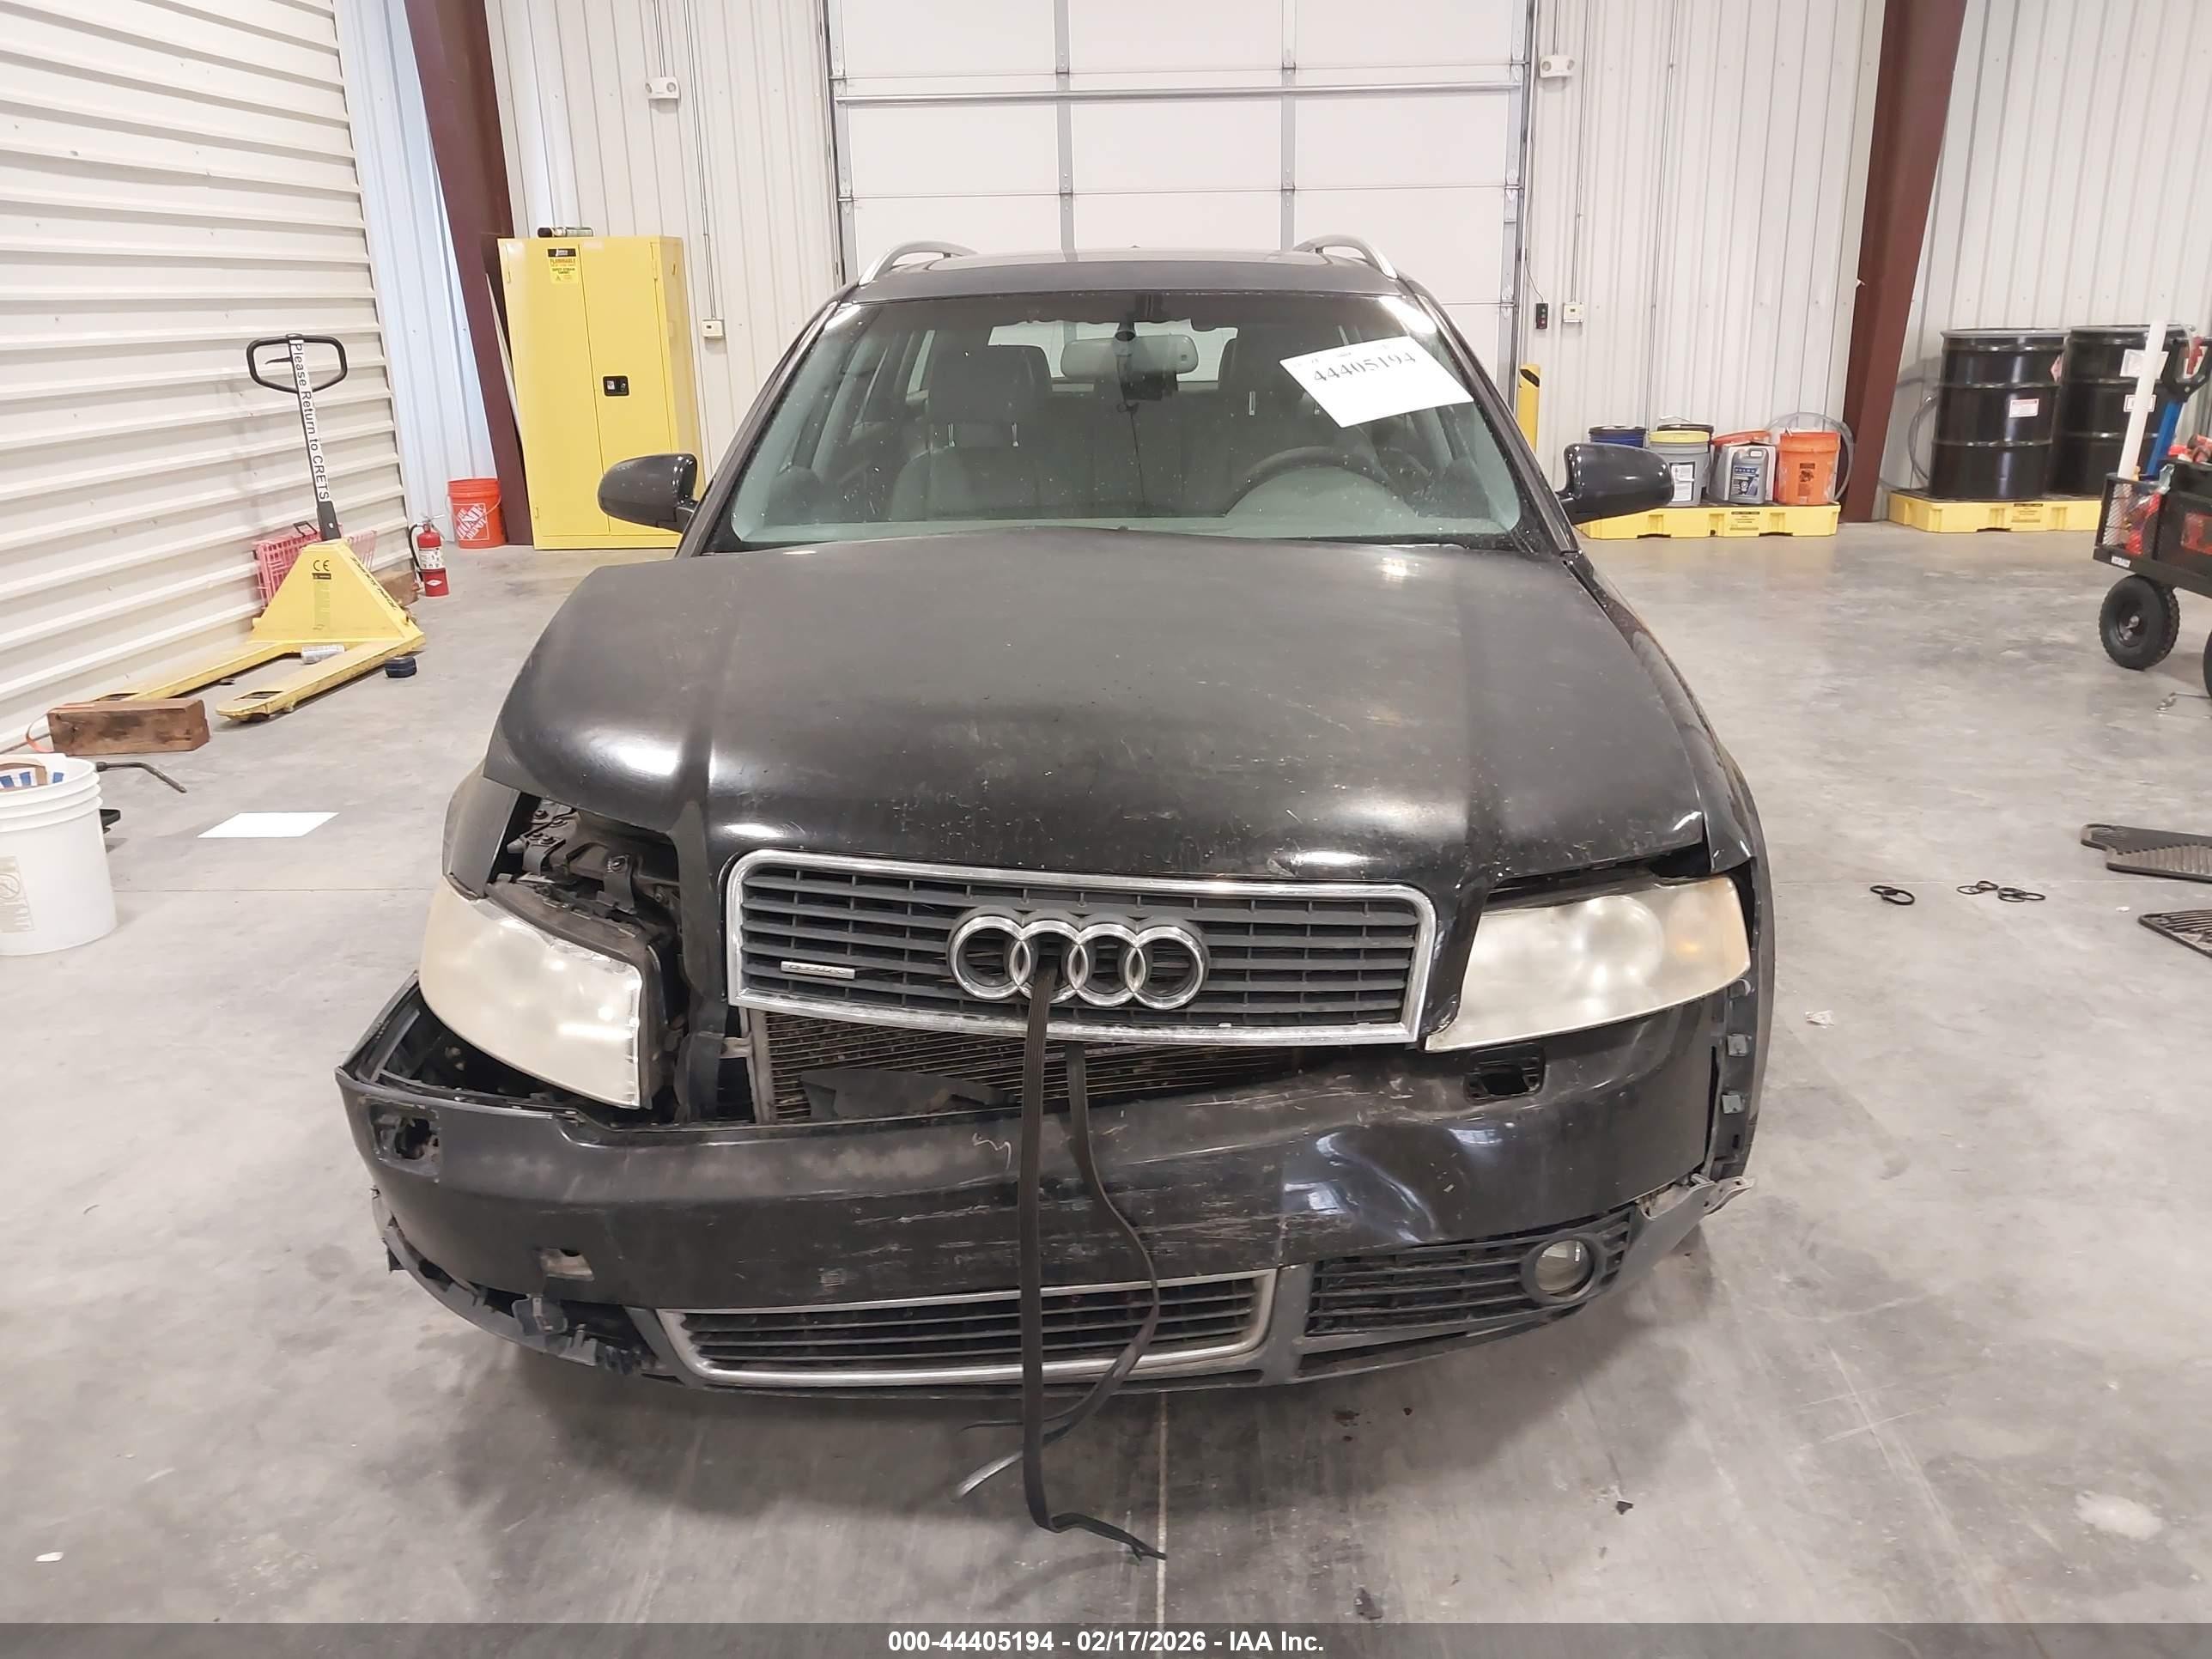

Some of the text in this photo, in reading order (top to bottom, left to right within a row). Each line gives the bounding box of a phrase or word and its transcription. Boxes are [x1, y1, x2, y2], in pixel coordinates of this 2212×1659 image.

[1314, 352, 1416, 380] 44405194
[293, 343, 330, 501] Please Return to CRETS
[456, 505, 484, 539] HOME
